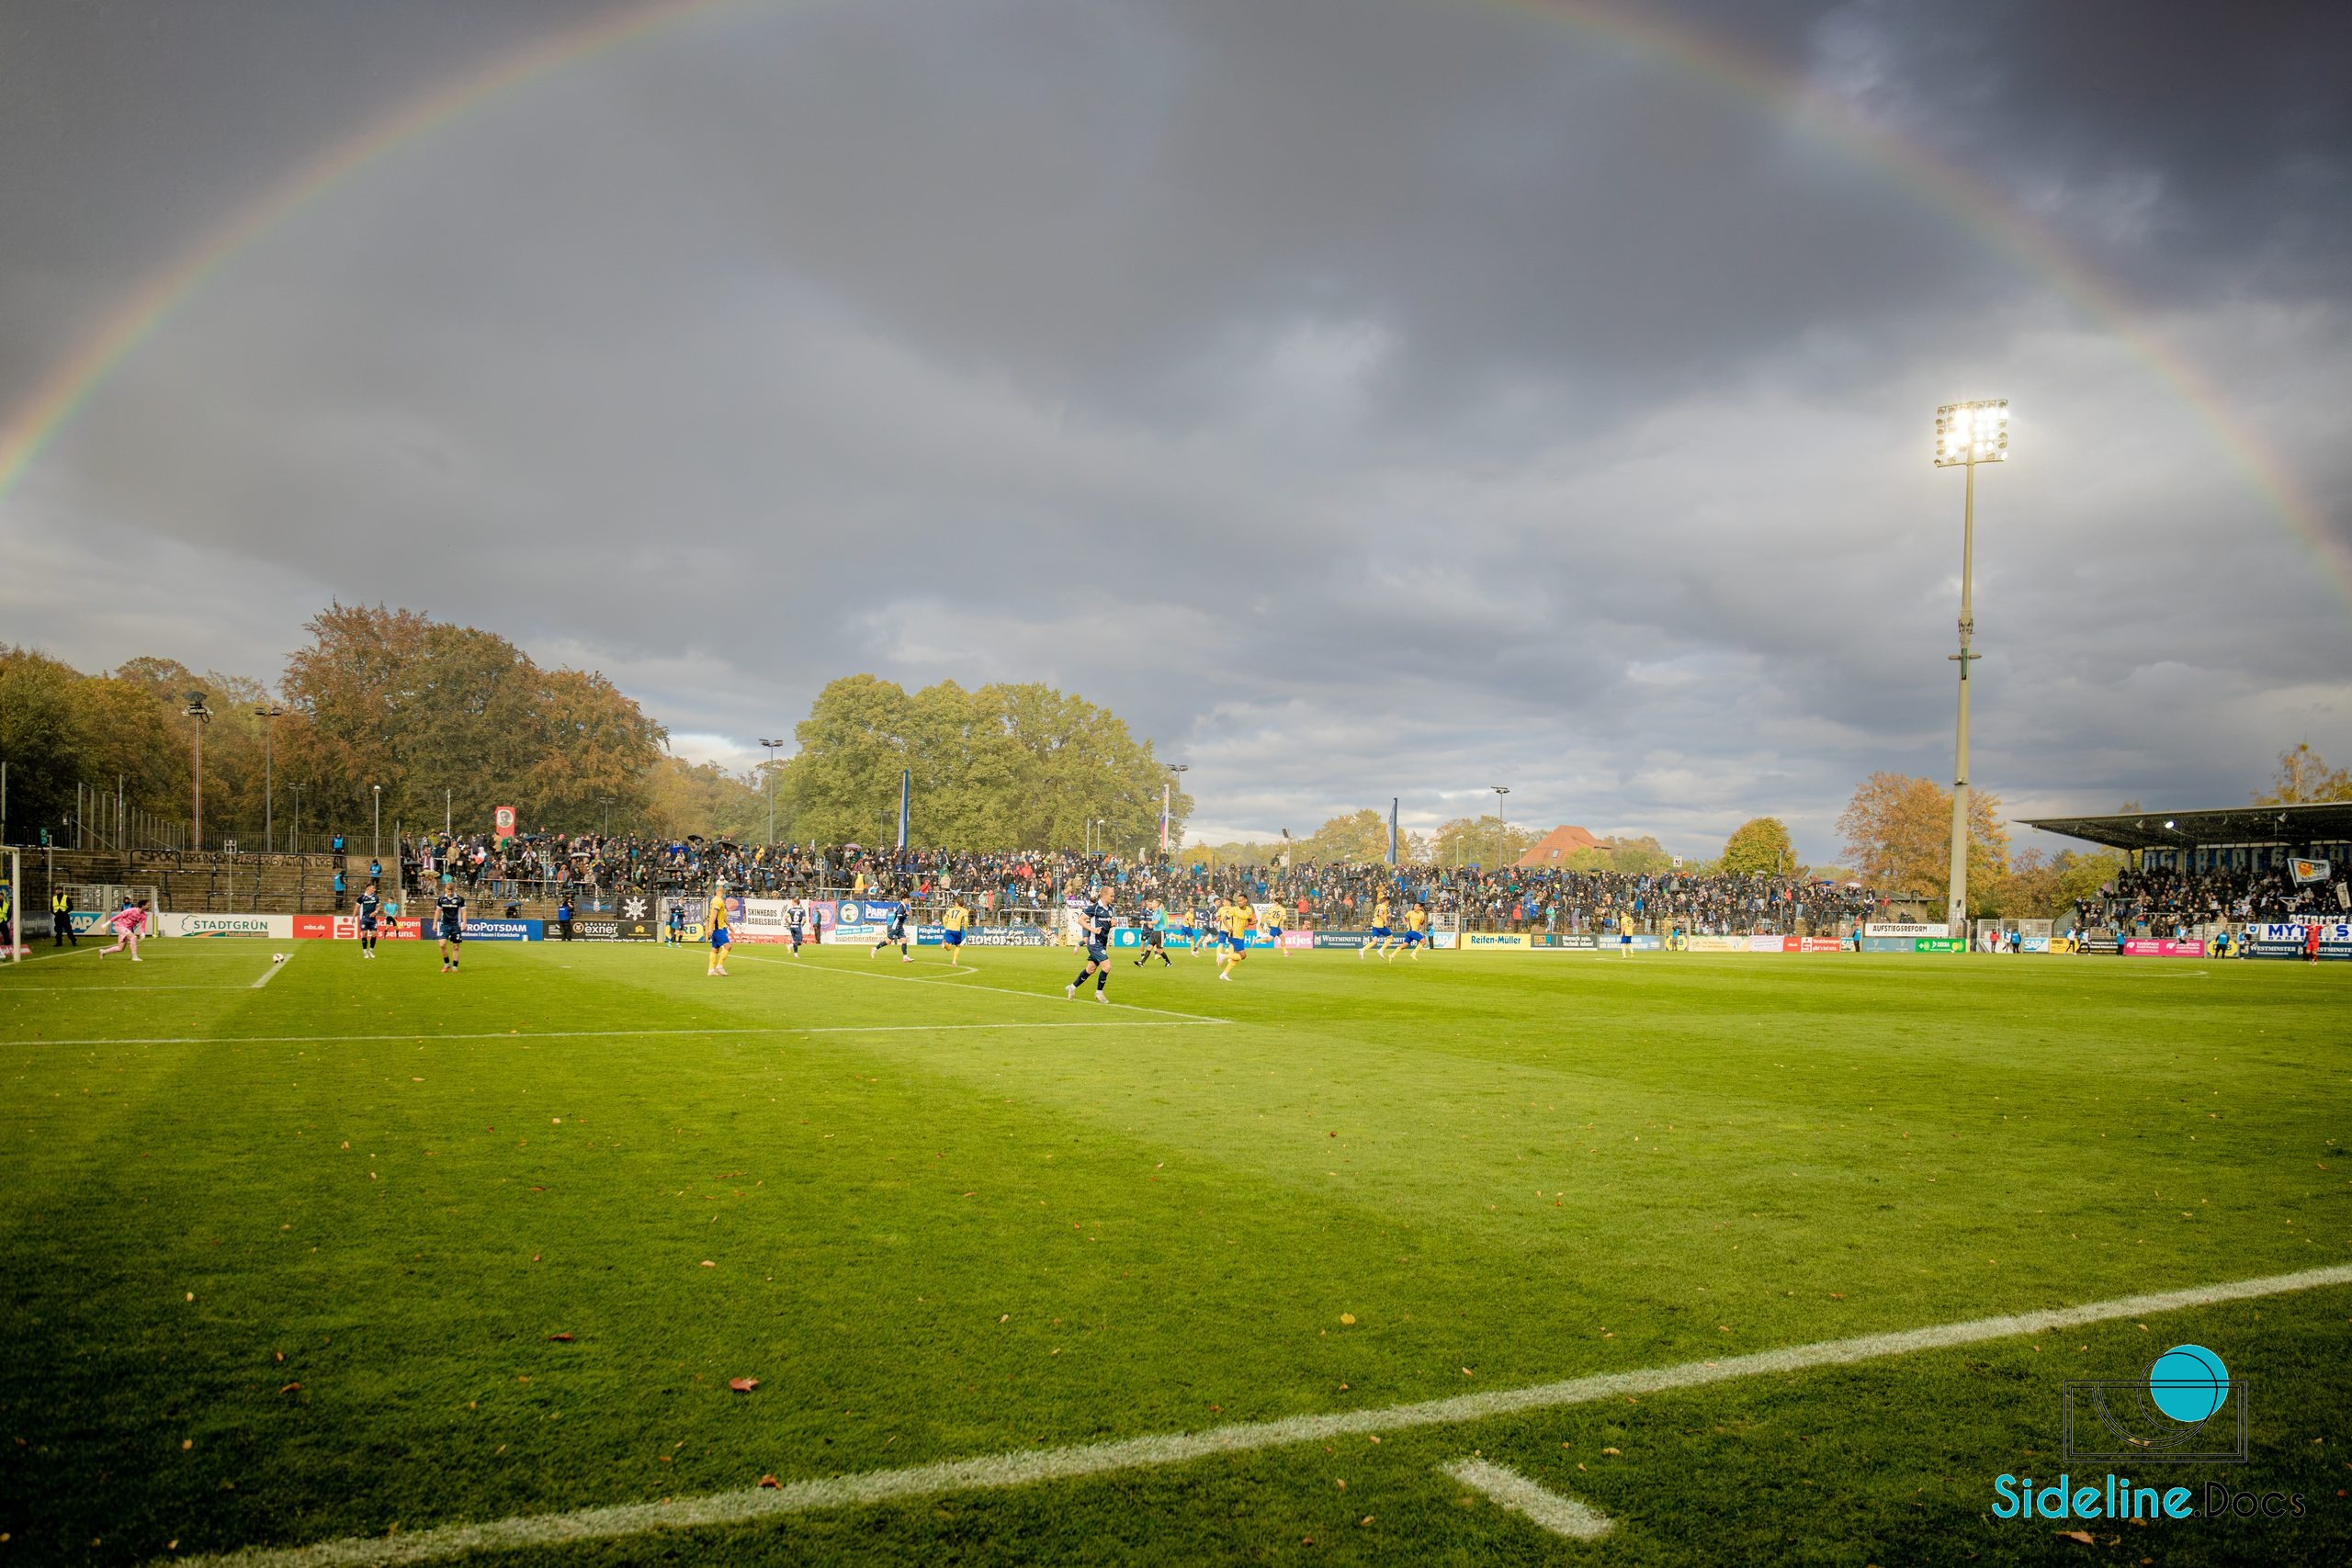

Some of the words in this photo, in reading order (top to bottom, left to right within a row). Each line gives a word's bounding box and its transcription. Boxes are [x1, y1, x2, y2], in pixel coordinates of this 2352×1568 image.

[748, 908, 777, 917] SKINHEADS
[793, 910, 800, 921] 6
[951, 909, 960, 919] 17
[194, 919, 268, 930] STADTGRÜN
[461, 921, 526, 931] ROPOTSDAM
[748, 918, 782, 926] BABELSBERG
[584, 925, 618, 933] exner
[683, 926, 697, 934] RB
[1322, 934, 1362, 942] WESTMINSTER
[1471, 935, 1521, 944] Reifen-Müller
[2024, 940, 2041, 949] SAP
